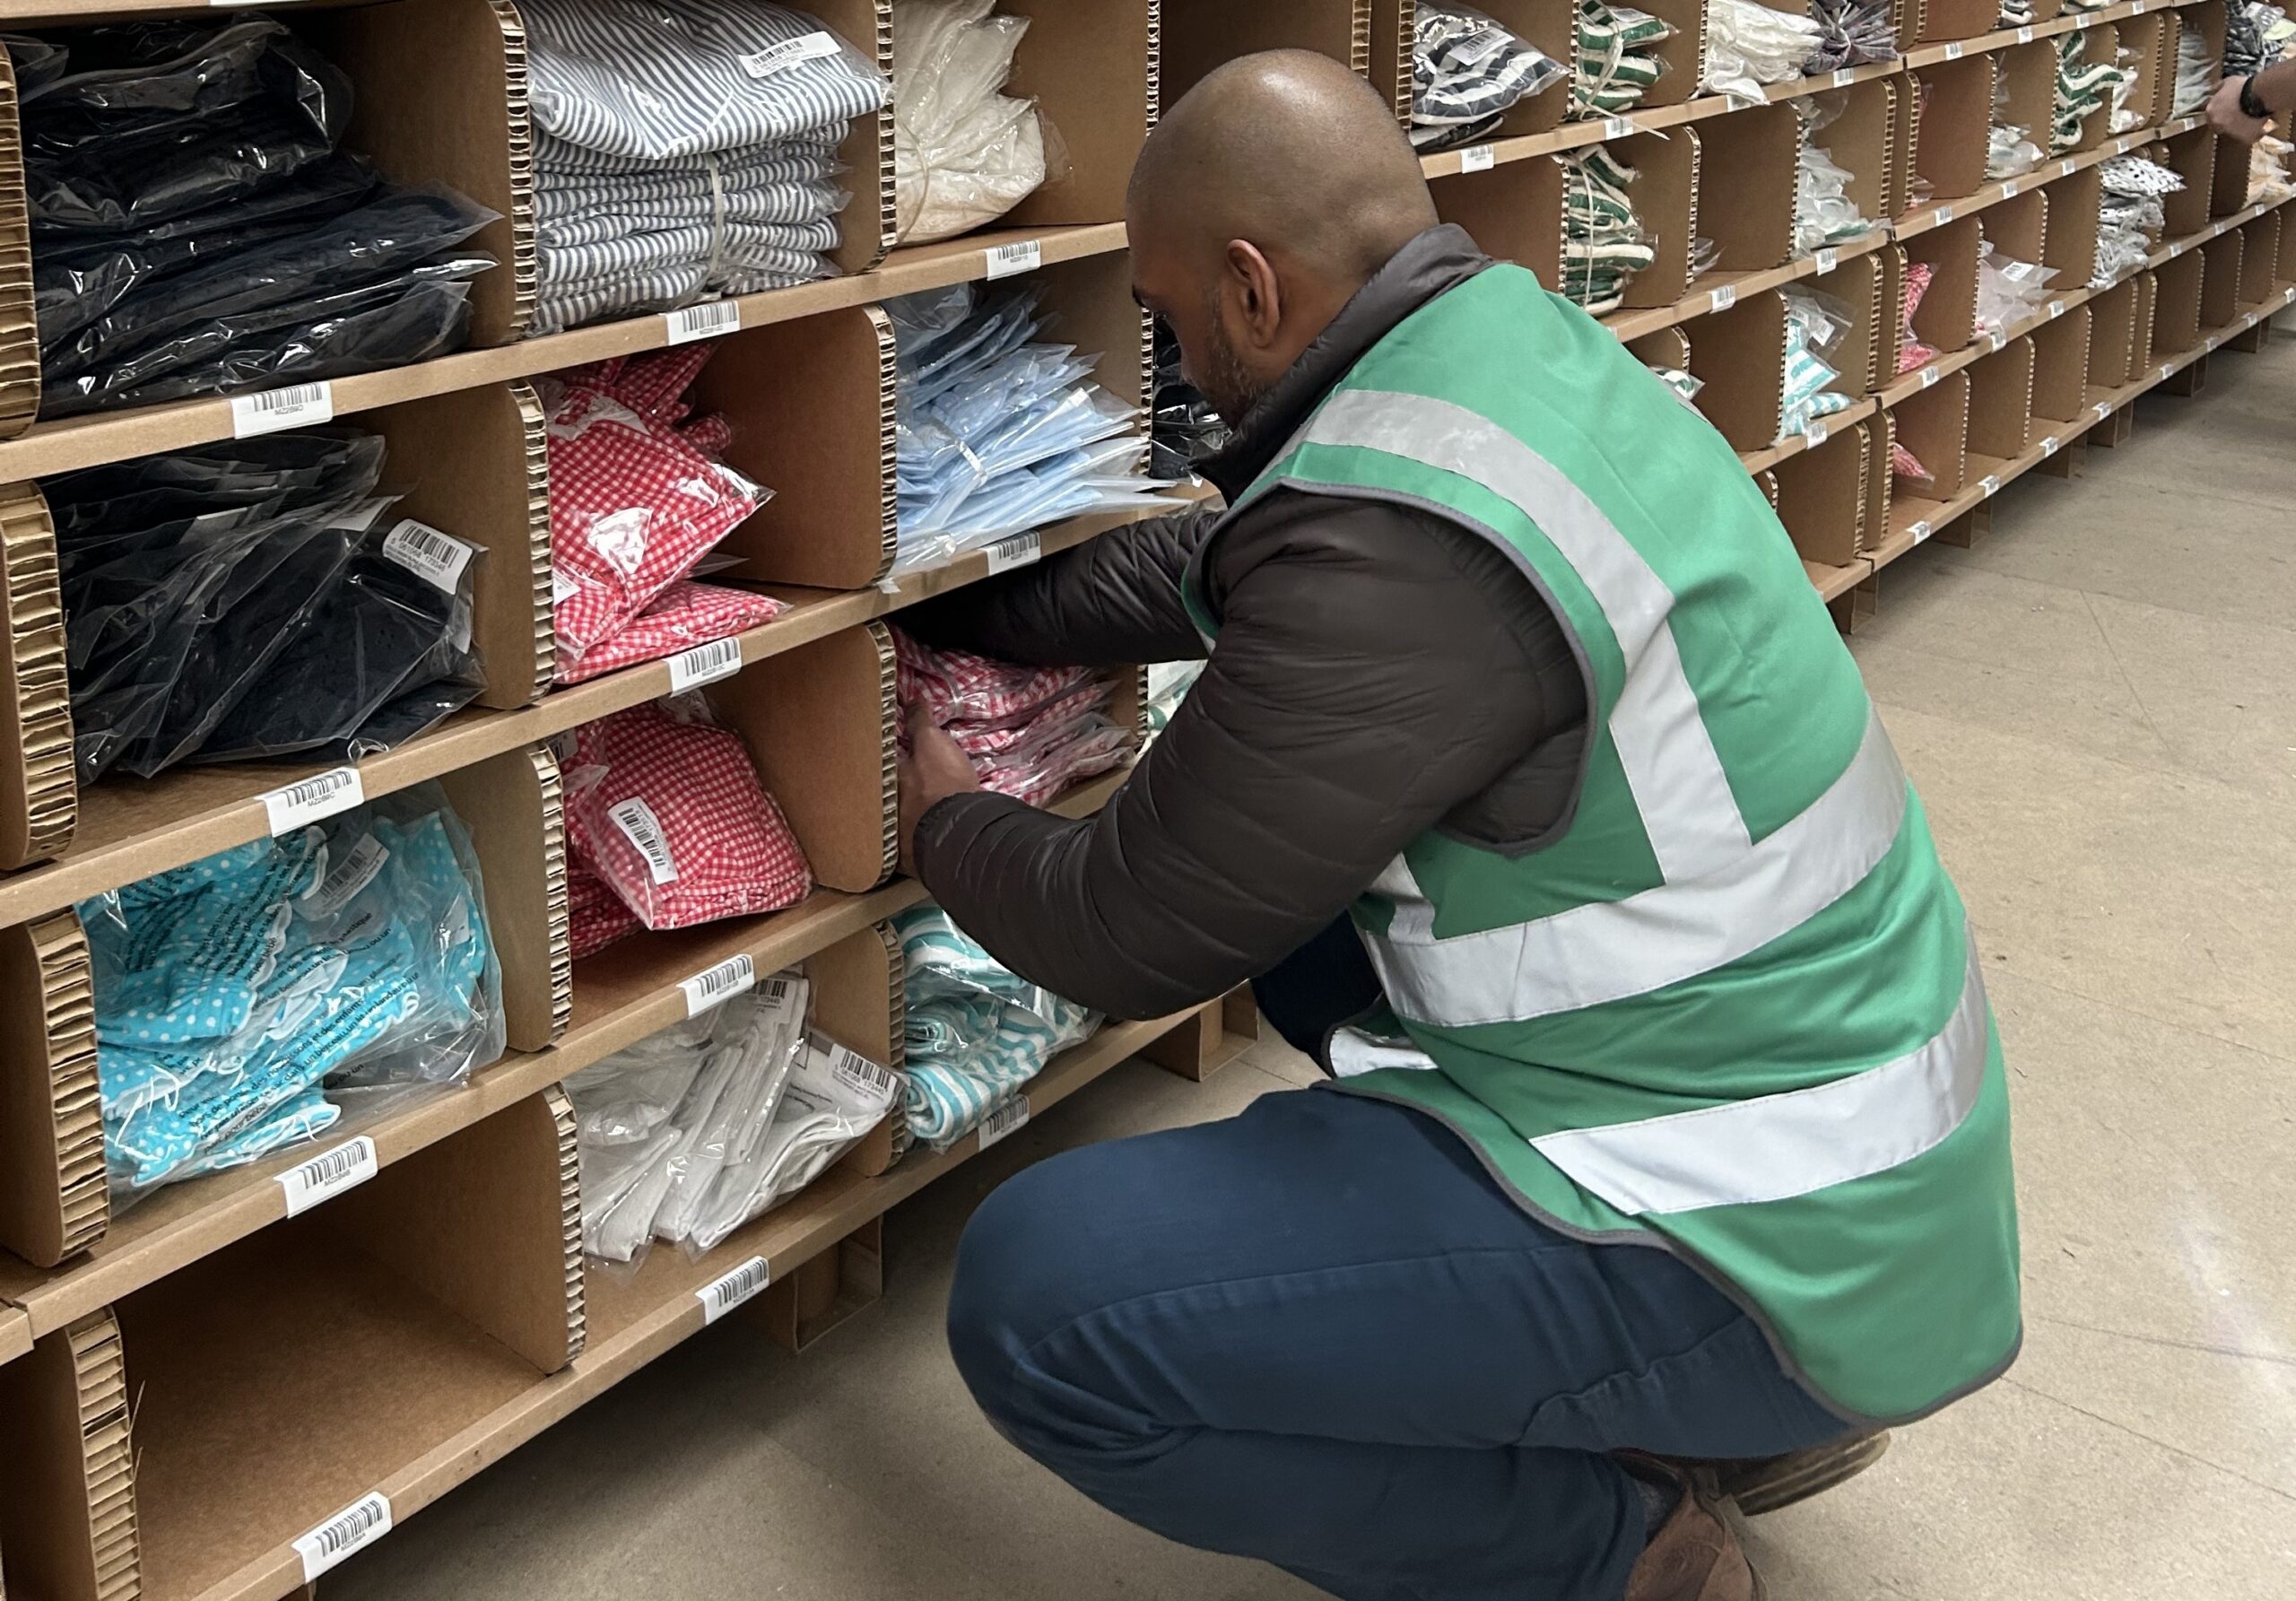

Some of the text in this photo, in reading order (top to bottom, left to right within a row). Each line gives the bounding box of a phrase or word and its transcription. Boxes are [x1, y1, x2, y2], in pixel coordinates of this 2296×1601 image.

[320, 1021, 335, 1035] des
[338, 1063, 363, 1082] ou un
